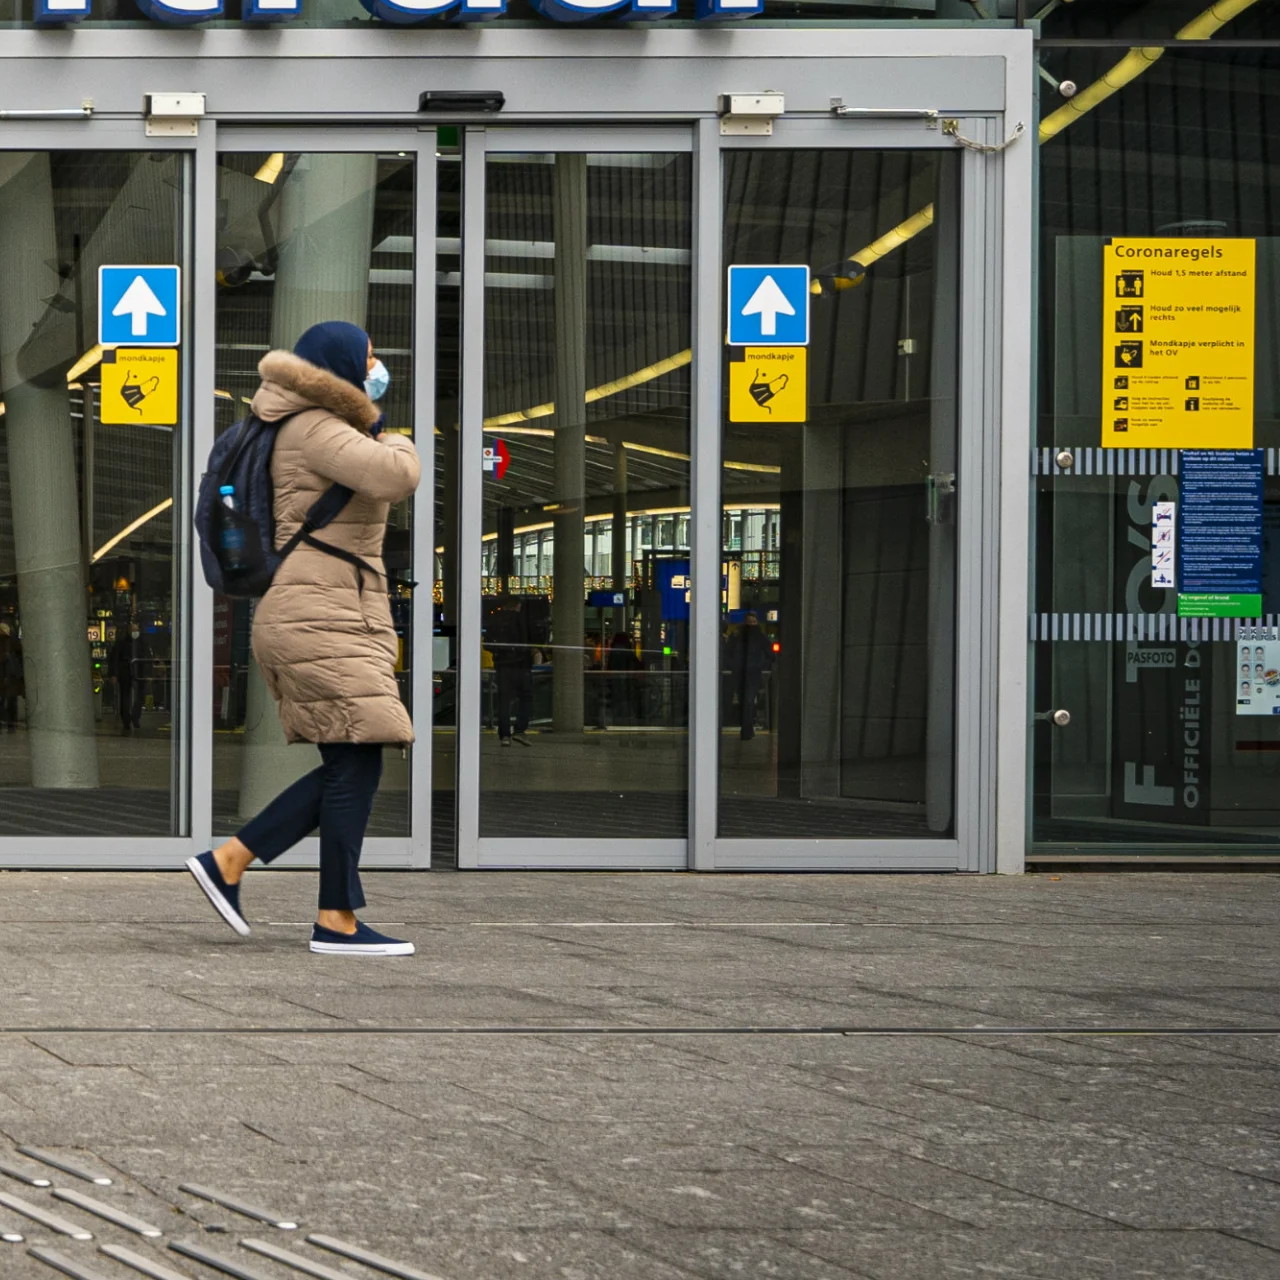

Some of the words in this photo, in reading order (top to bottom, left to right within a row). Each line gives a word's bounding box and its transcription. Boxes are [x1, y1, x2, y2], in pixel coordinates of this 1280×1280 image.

[1114, 244, 1223, 262] Coronaregels
[1150, 269, 1173, 277] Houd
[1175, 269, 1187, 278] 1,5
[1215, 269, 1247, 277] afstand
[1149, 304, 1173, 312] Houd
[1186, 304, 1204, 312] veel
[1205, 304, 1242, 314] mogelijk
[1149, 313, 1176, 321] rechts
[1149, 339, 1196, 349] Mondkapje
[1197, 340, 1235, 349] verplicht
[747, 352, 795, 362] mondkapje
[1149, 349, 1163, 357] het
[1165, 349, 1179, 357] OV
[118, 354, 166, 364] mondkapje
[1127, 651, 1175, 664] PASFOTO
[1180, 678, 1201, 809] OFFICIËLE
